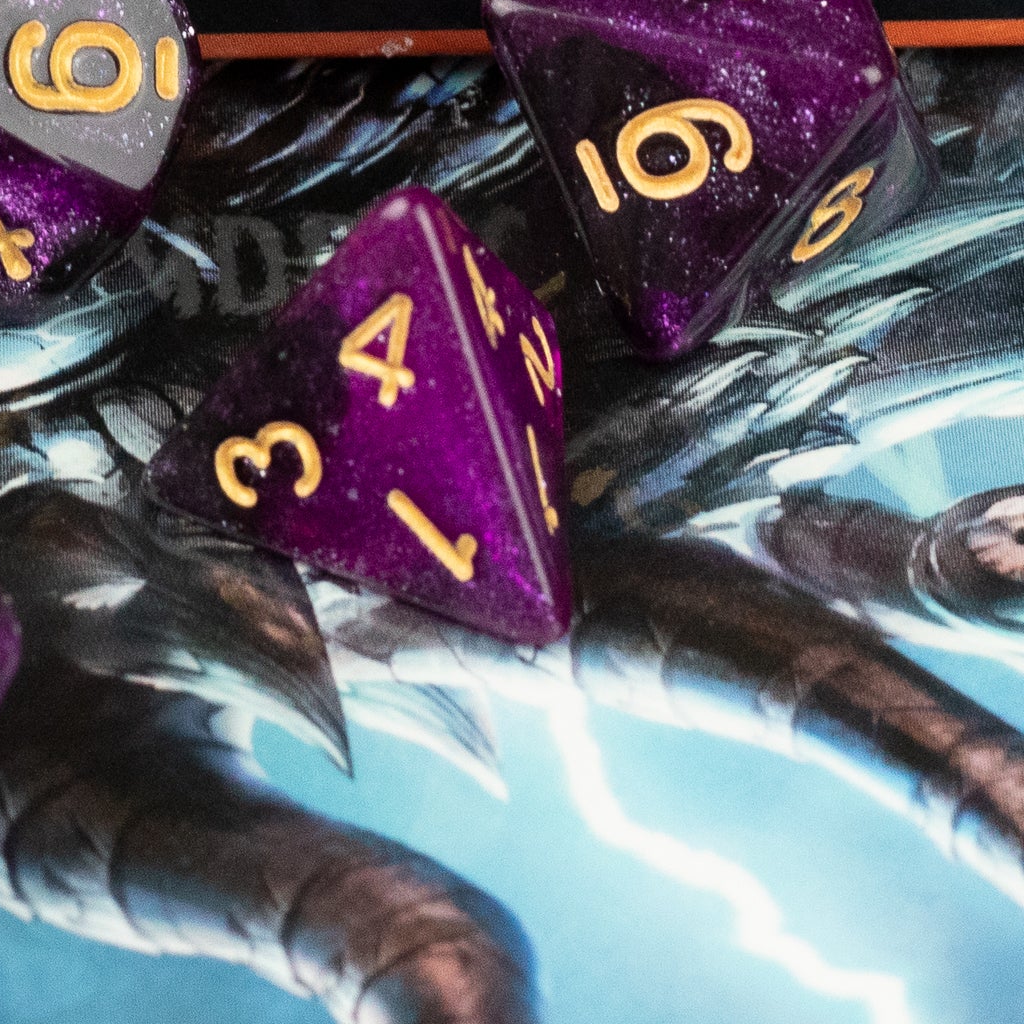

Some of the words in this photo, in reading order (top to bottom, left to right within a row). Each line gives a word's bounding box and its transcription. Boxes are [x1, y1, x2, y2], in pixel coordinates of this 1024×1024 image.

[338, 295, 413, 404] 4
[215, 421, 322, 508] 3
[388, 491, 476, 581] 1
